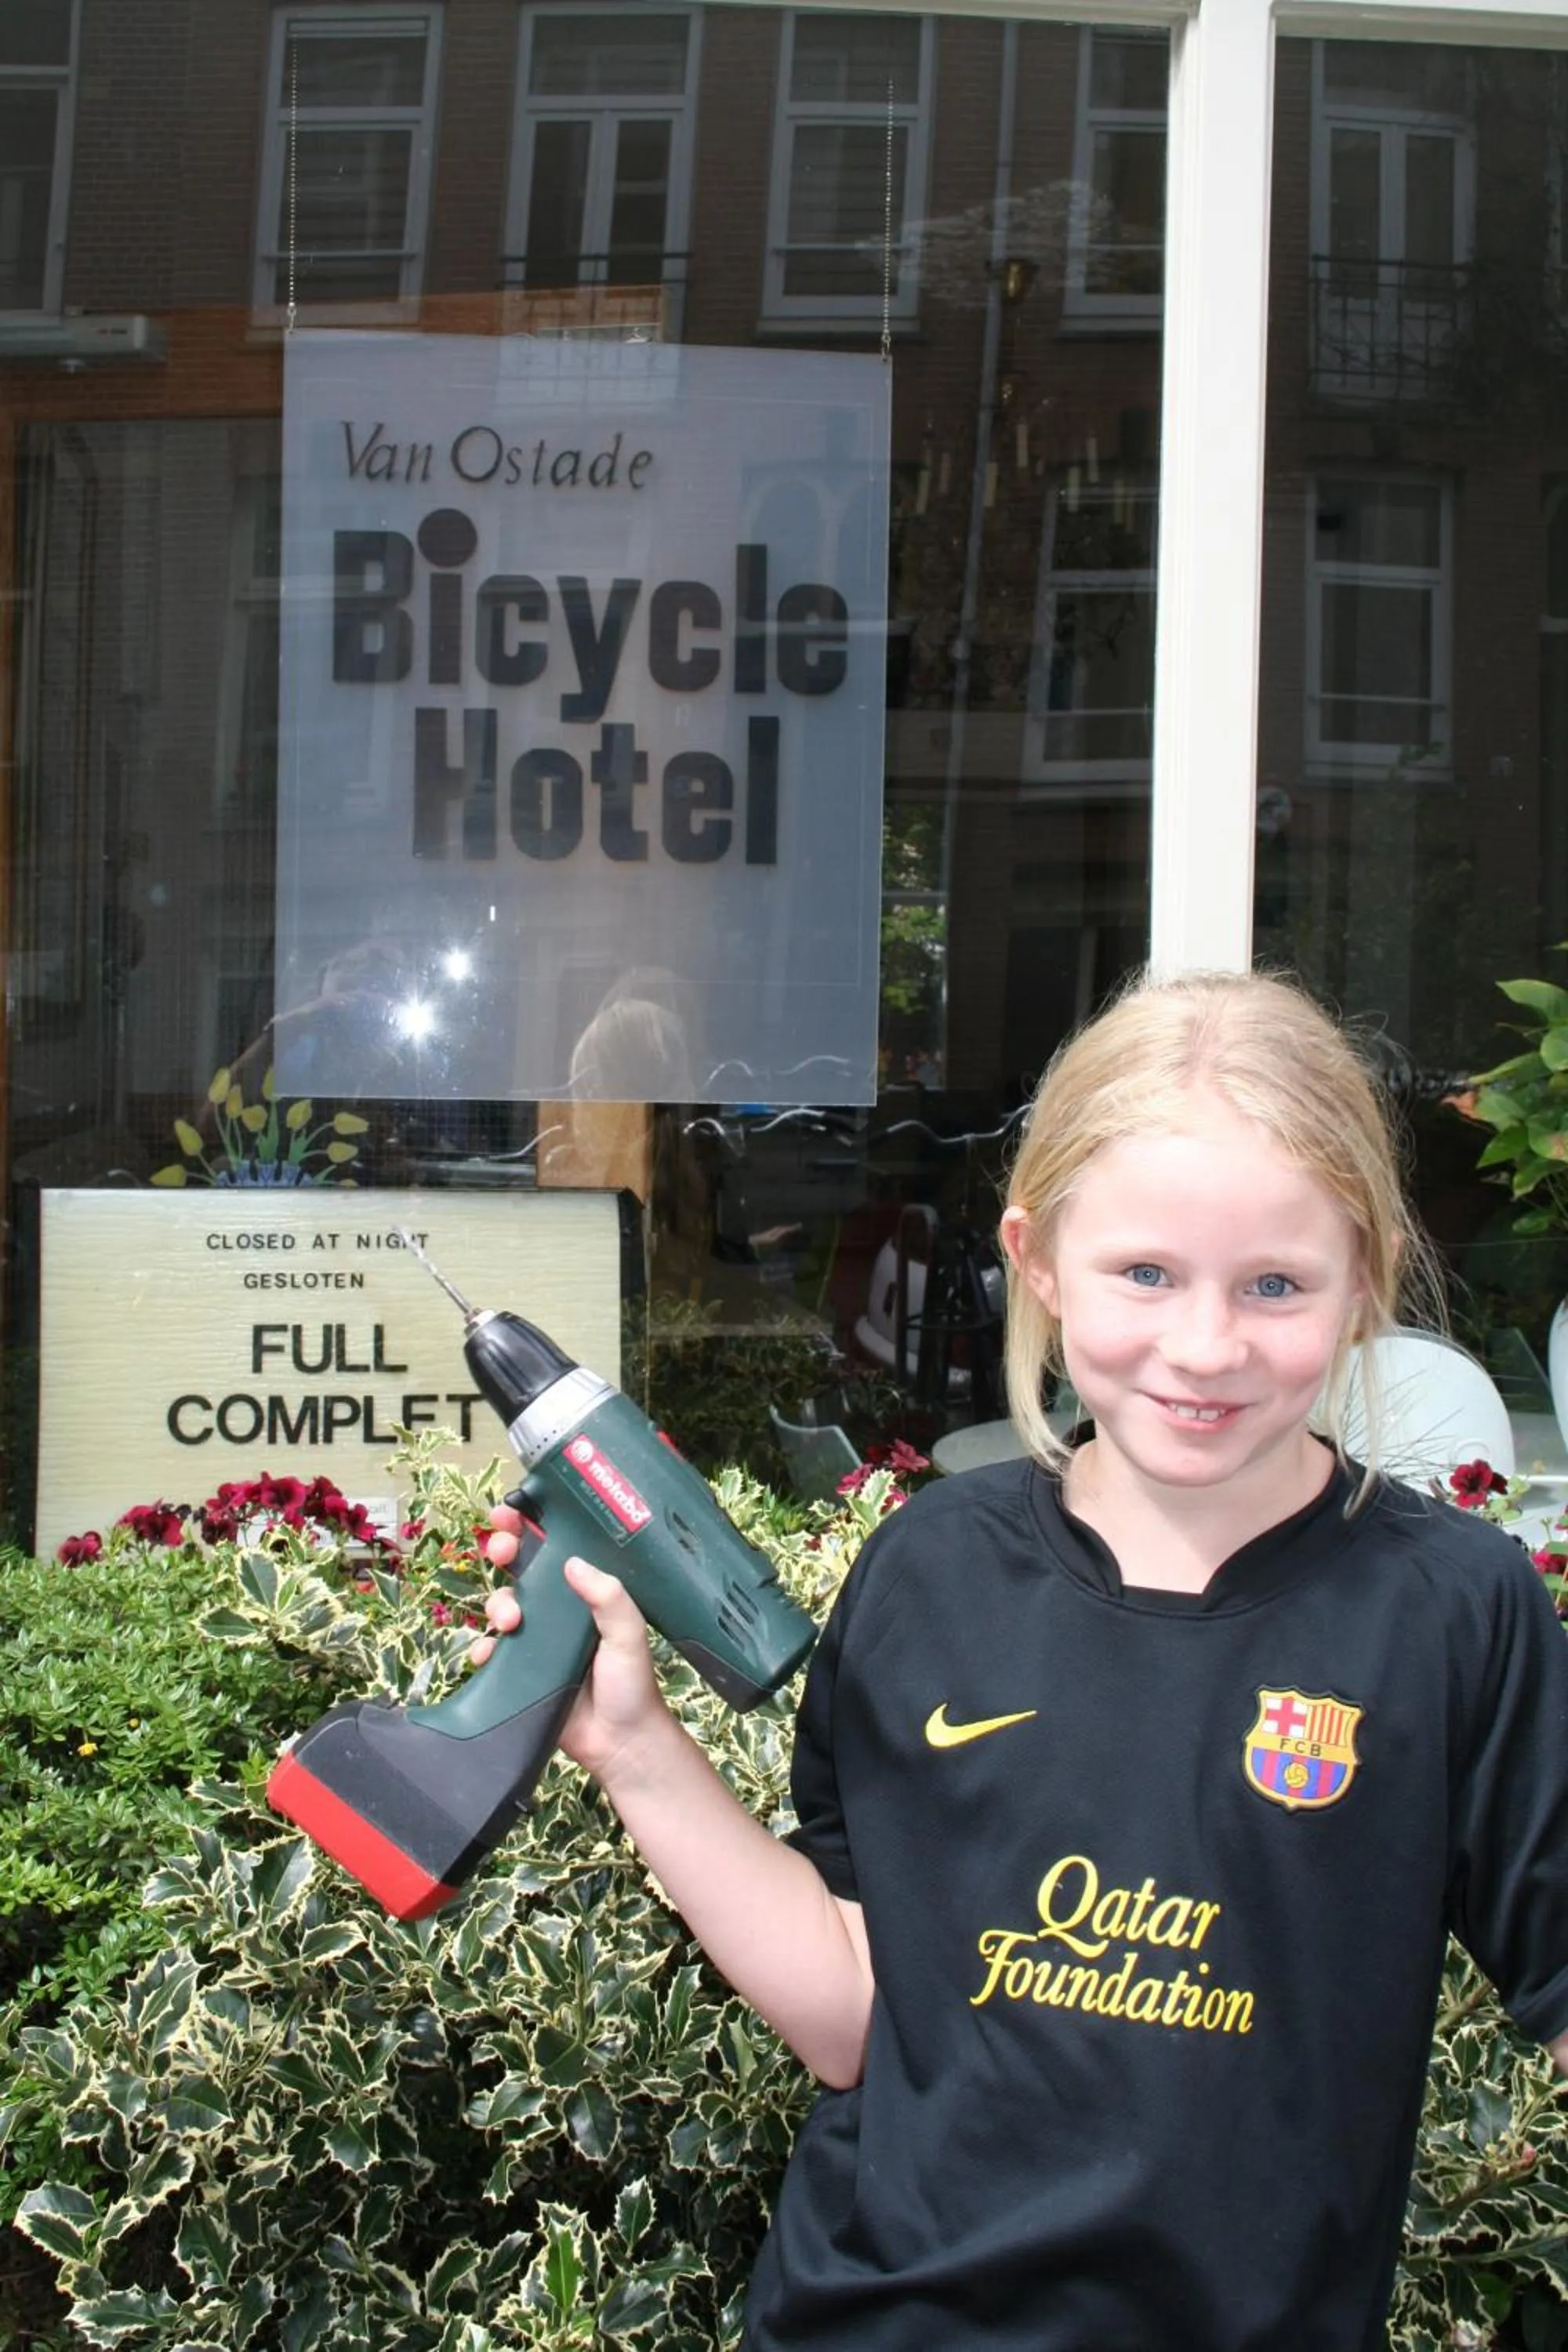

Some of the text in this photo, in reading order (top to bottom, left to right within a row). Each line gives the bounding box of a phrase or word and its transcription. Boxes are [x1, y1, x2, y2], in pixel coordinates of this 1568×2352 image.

[341, 420, 654, 490] Van Ostade
[333, 508, 849, 724] Bicycle
[412, 707, 780, 866] Hotel
[206, 1232, 296, 1250] CLOSED
[311, 1232, 340, 1250] AT
[243, 1272, 365, 1290] GESLOTEN
[252, 1323, 408, 1374] FULL
[167, 1393, 490, 1446] COMPLET
[589, 1460, 648, 1525] metabo
[1279, 1737, 1322, 1757] FCB
[1036, 1854, 1221, 1958] Qatar
[969, 1929, 1254, 2034] Foundation
